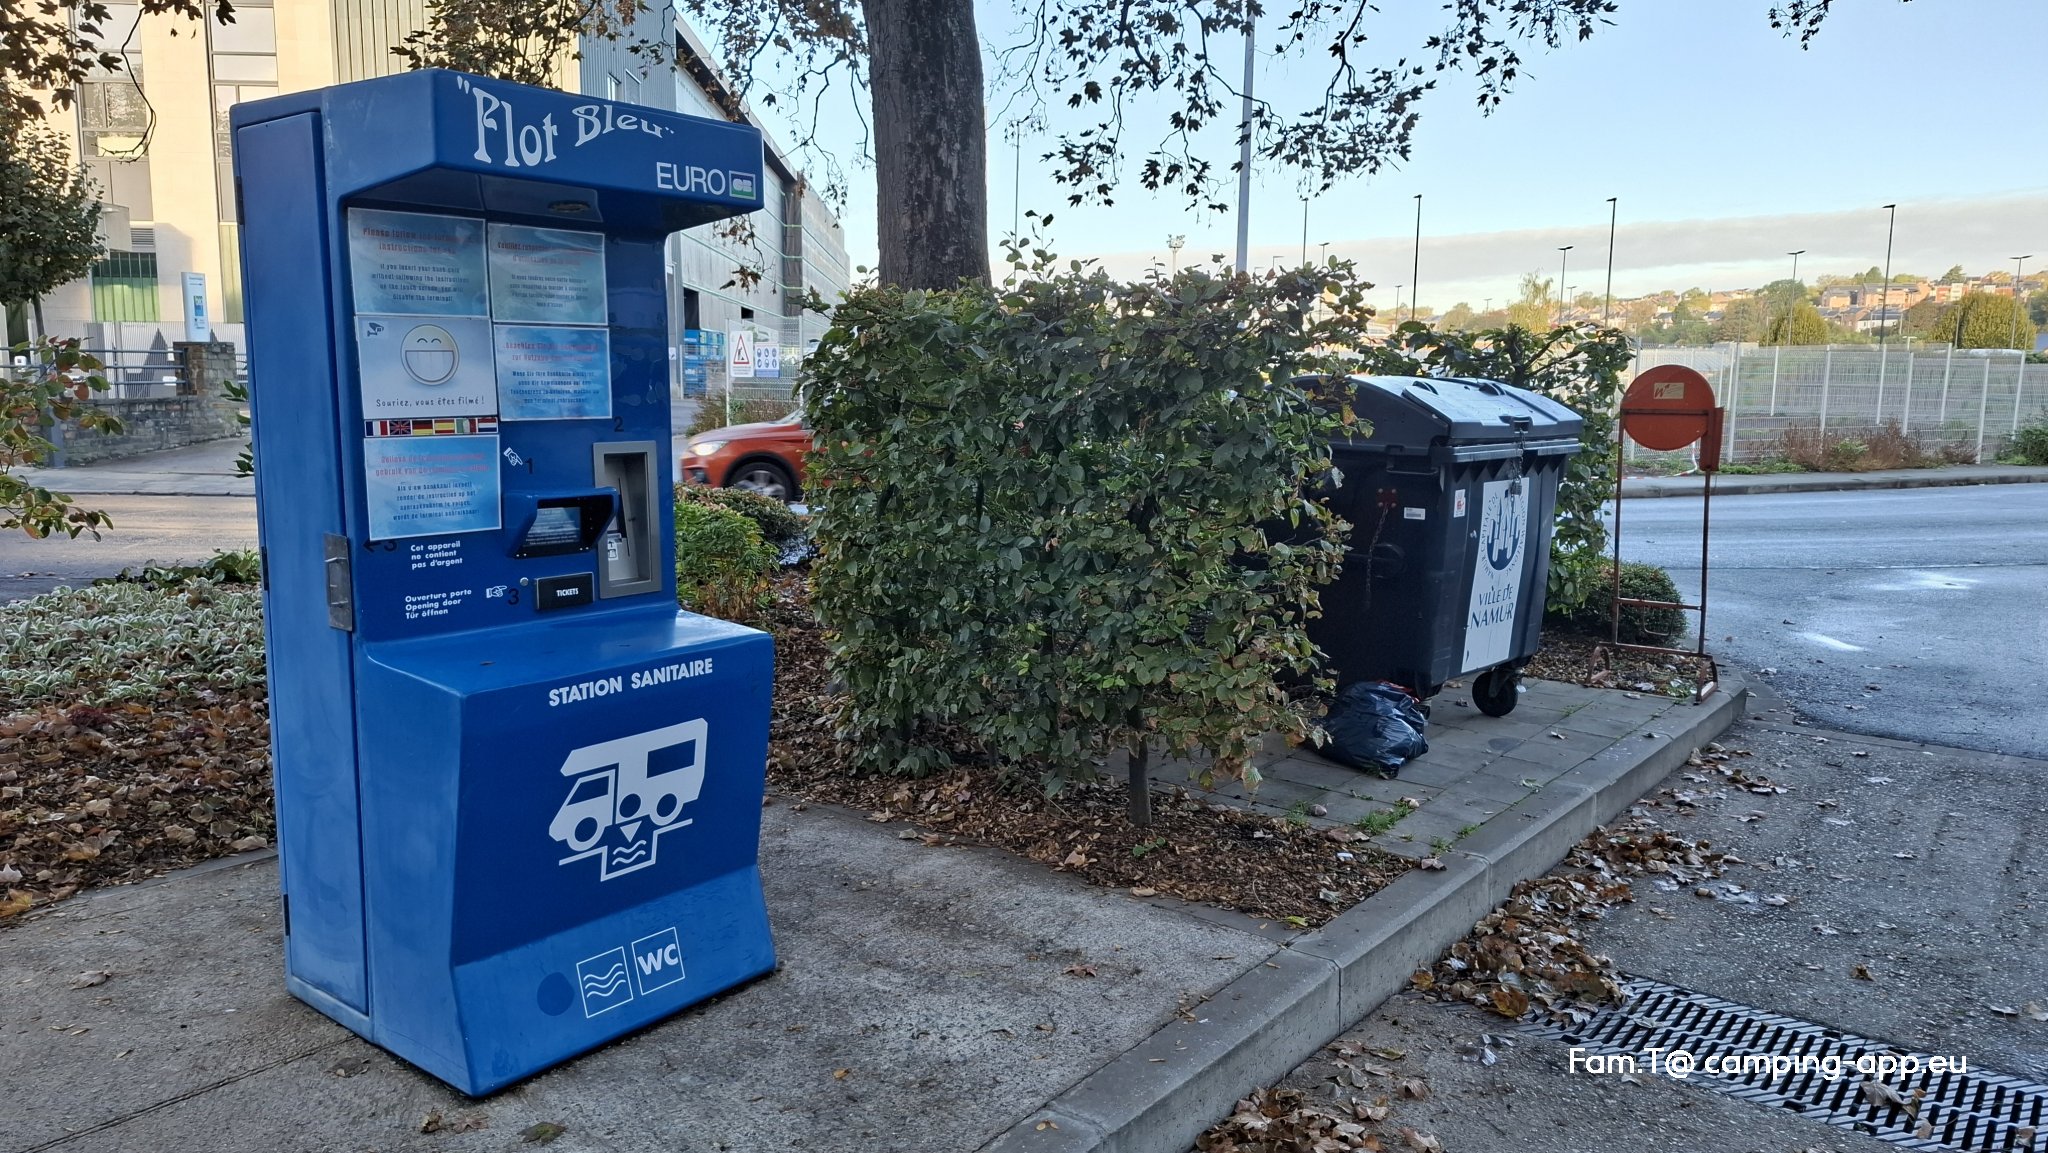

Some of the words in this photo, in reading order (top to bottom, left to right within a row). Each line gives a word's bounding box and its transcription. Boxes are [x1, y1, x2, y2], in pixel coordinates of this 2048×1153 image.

[656, 161, 726, 196] EURO
[376, 398, 412, 408] Souriez,
[437, 397, 455, 405] êtes
[614, 416, 624, 432] 2
[526, 458, 533, 474] 1
[410, 544, 423, 552] Cet
[428, 540, 461, 551] appareil
[425, 550, 457, 559] contient
[411, 562, 426, 570] pas
[430, 557, 463, 567] d'argent
[405, 592, 447, 603] Ouverture
[450, 589, 472, 598] porte
[507, 588, 519, 605] 3
[556, 587, 578, 597] TICKETS
[1479, 587, 1502, 606] VILLE
[405, 601, 439, 611] Opening
[442, 598, 461, 606] door
[405, 612, 419, 620] Tür
[421, 608, 448, 617] öffnen
[1470, 602, 1514, 629] NAMUR
[548, 675, 623, 707] STATION
[631, 657, 713, 689] SANITAIRE
[637, 942, 679, 976] WC
